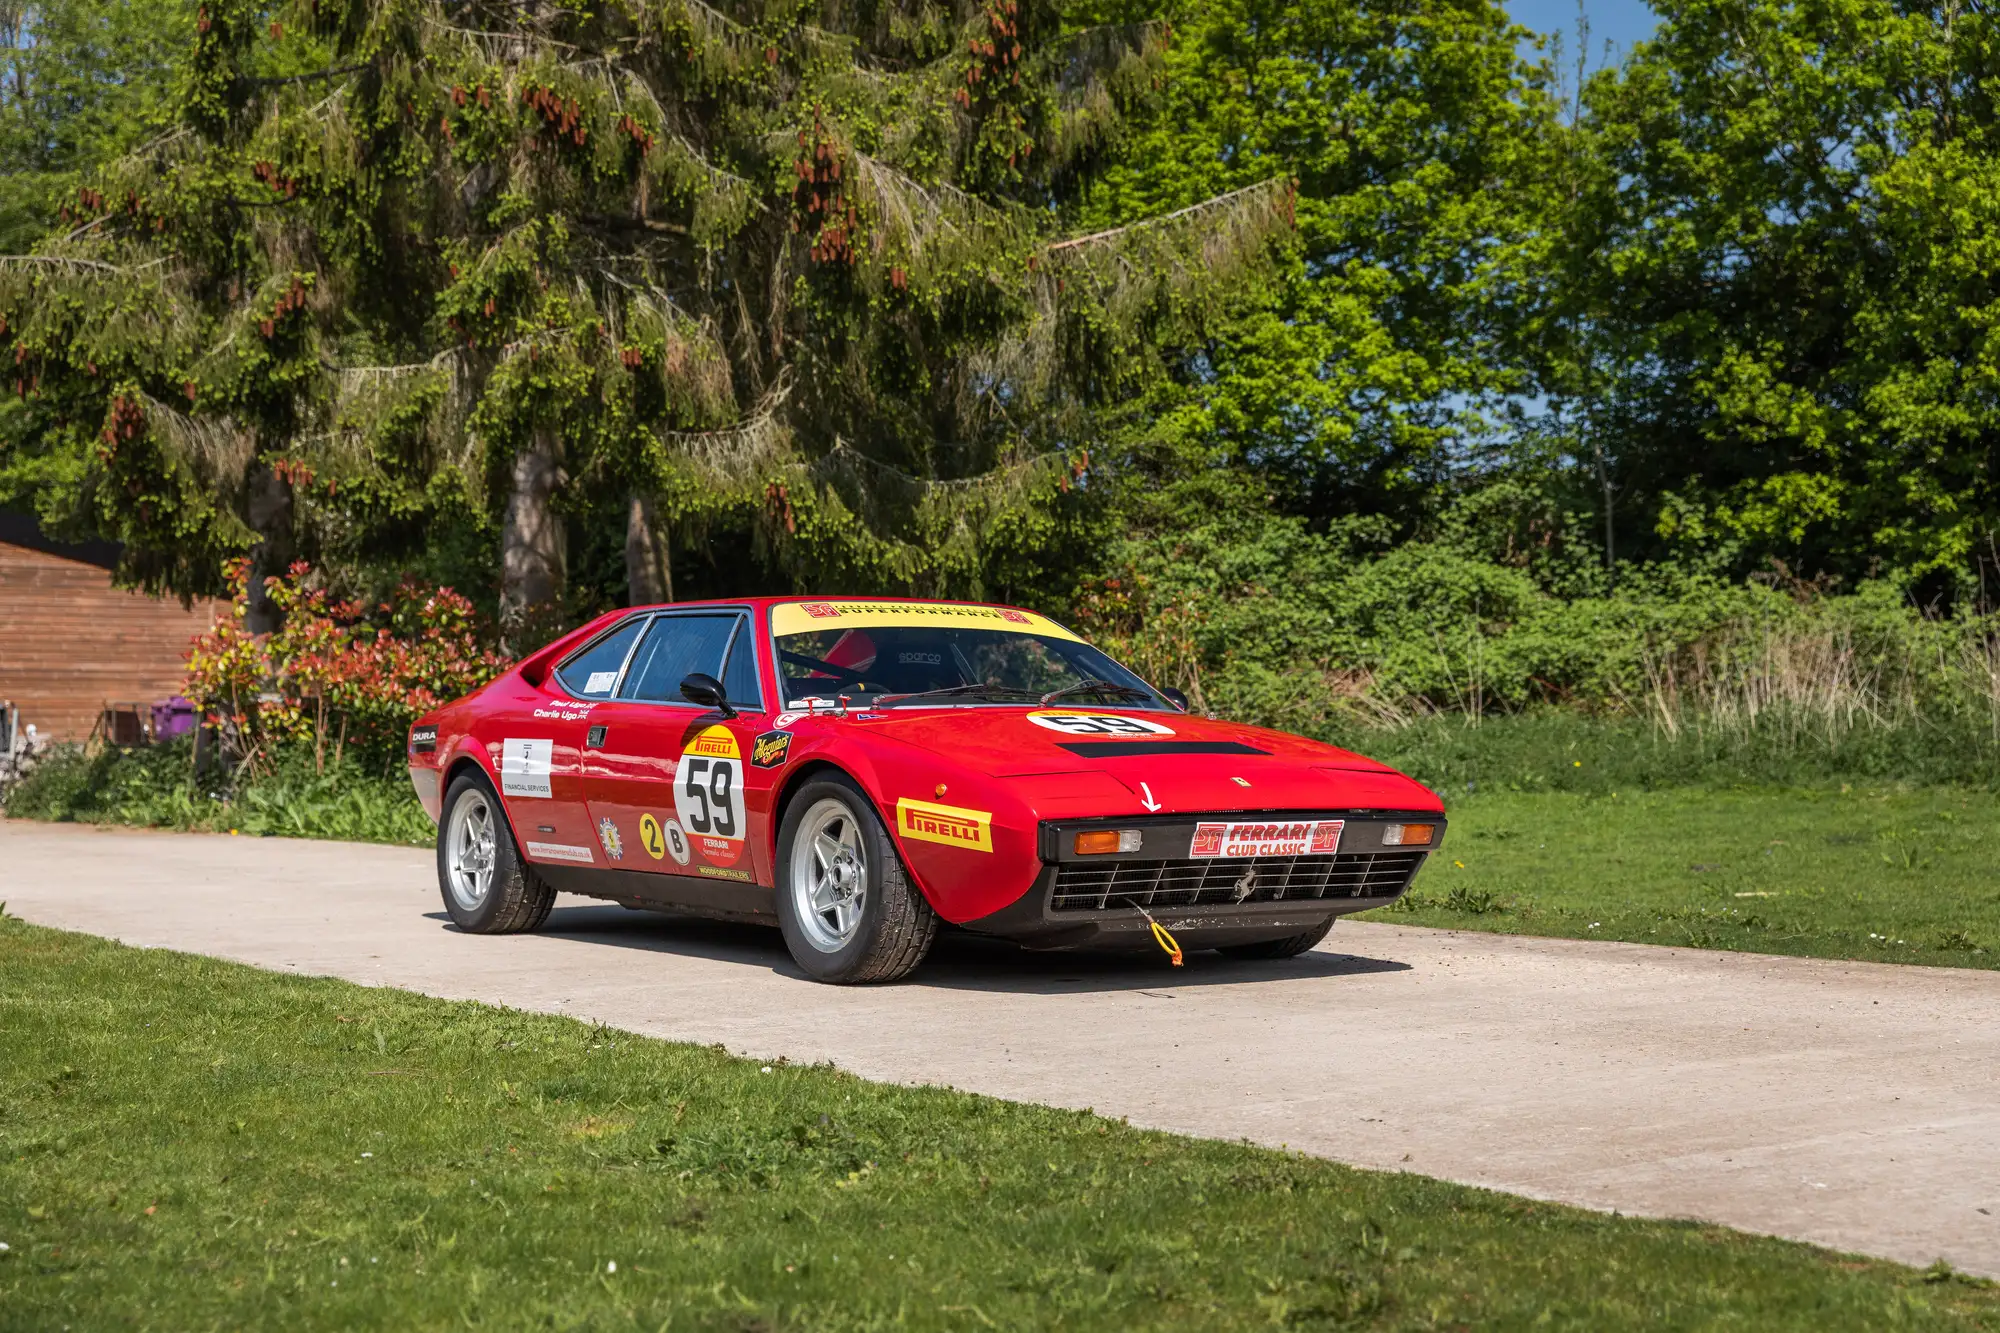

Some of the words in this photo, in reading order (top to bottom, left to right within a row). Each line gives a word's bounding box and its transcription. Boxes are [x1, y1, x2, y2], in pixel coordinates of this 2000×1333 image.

[899, 652, 941, 663] sparco
[533, 708, 560, 719] Charlie
[561, 710, 577, 721] Ugo
[1040, 716, 1156, 733] 59
[412, 731, 436, 741] DURA
[695, 735, 733, 754] PIRELLI
[504, 783, 527, 791] FINANCIAL
[527, 784, 549, 793] SERVICES
[686, 758, 736, 837] 59
[905, 807, 980, 843] PIRELLI
[1229, 823, 1312, 841] FERRARI
[644, 818, 662, 853] 2
[669, 828, 684, 854] B
[703, 838, 729, 849] FERRARI
[1226, 844, 1257, 857] CLUB
[1257, 842, 1306, 856] CLASSIC
